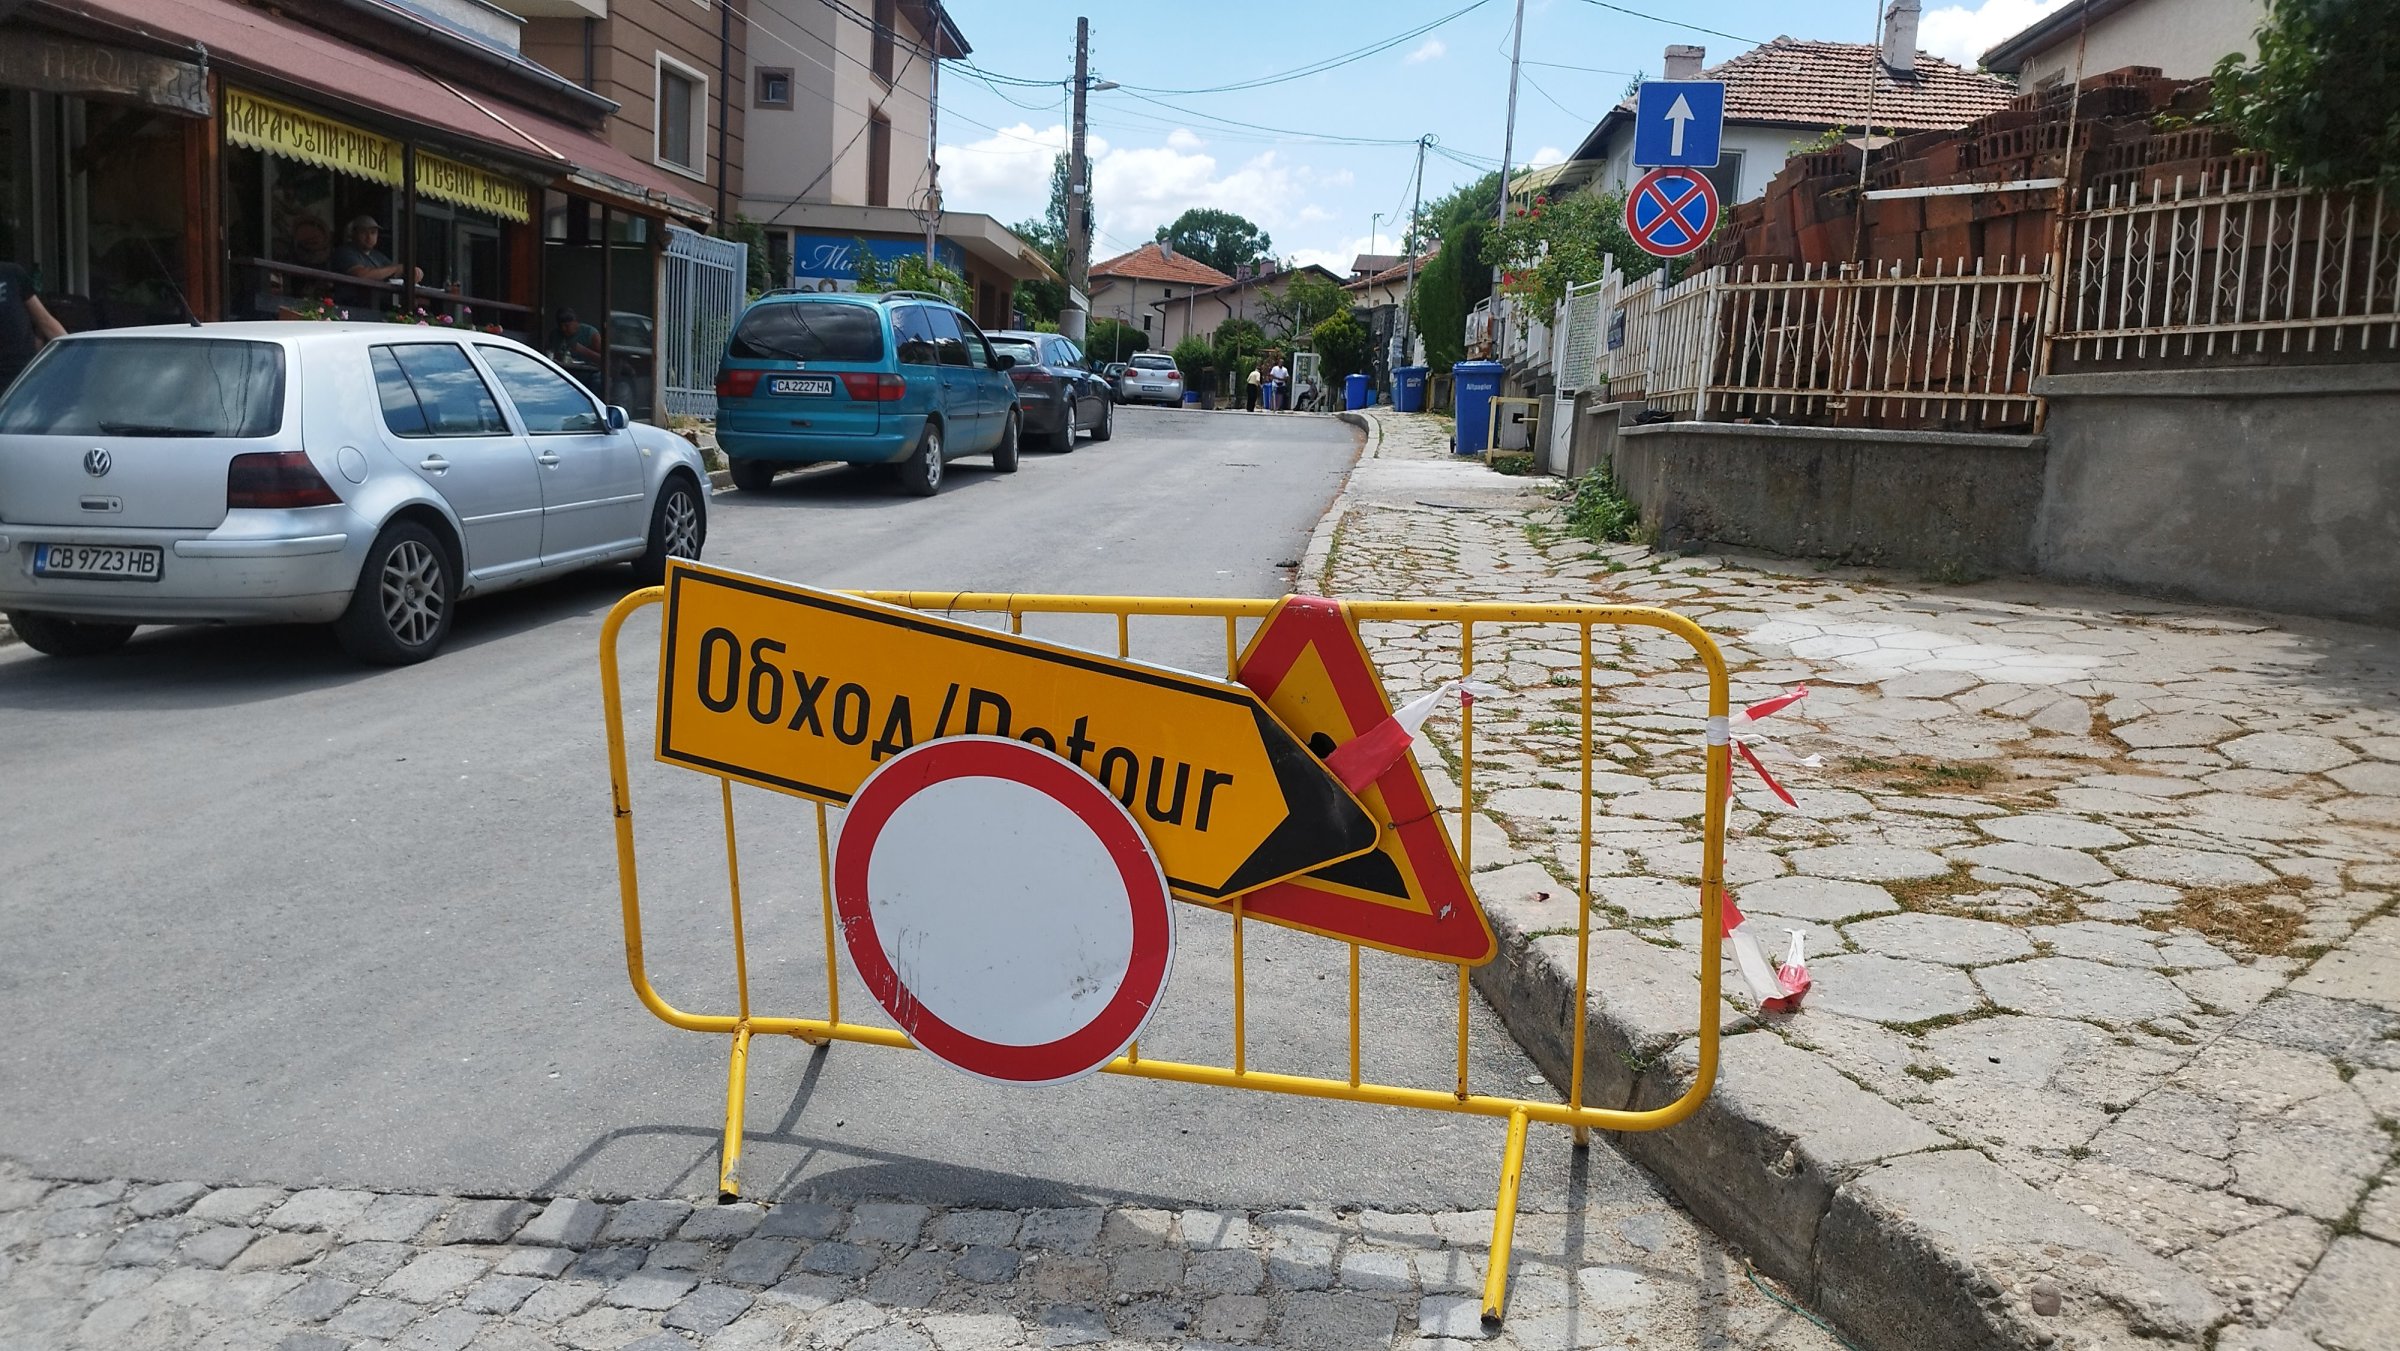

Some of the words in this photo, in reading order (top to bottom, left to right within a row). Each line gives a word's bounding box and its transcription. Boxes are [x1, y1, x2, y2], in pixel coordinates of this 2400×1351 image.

[225, 94, 282, 143] КАРА
[792, 381, 817, 392] 2227
[49, 547, 74, 569] CB
[78, 548, 125, 571] 9723
[127, 550, 155, 574] HB
